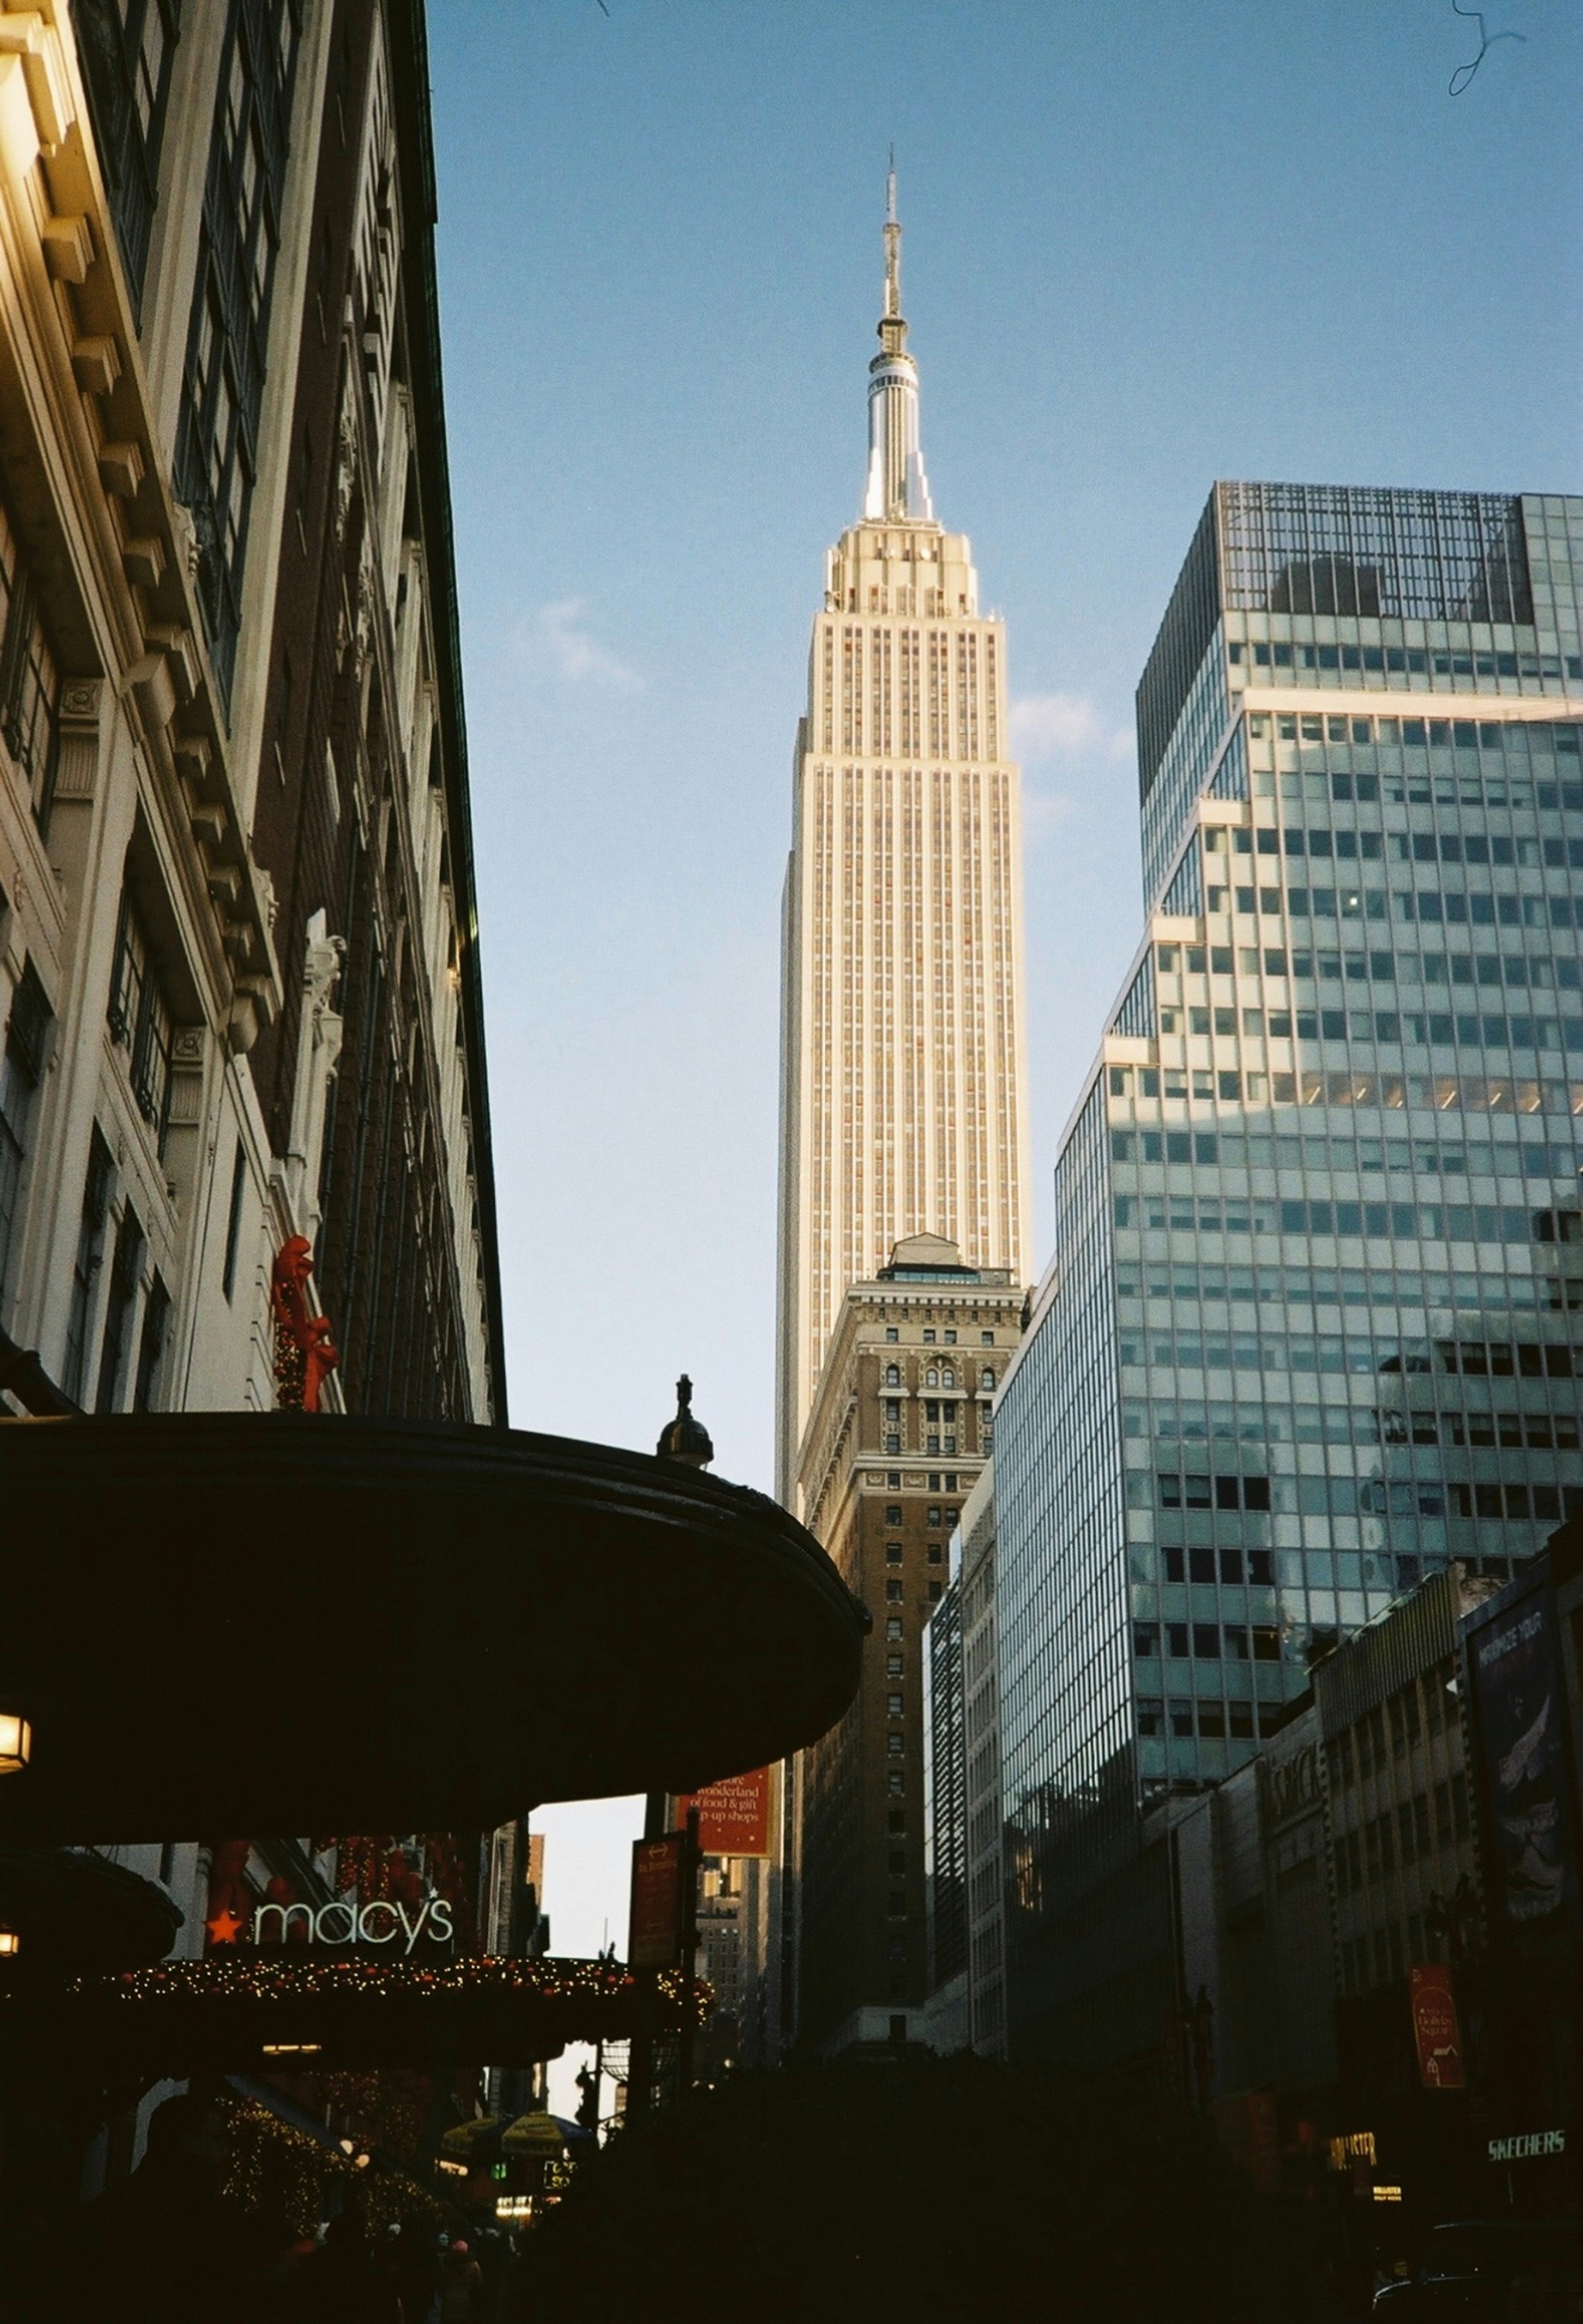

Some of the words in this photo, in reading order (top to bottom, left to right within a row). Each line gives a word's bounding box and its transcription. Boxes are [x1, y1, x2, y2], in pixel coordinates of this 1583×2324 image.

[697, 1785, 760, 1797] wonderland
[689, 1797, 701, 1806] of
[701, 1797, 727, 1808] food
[729, 1798, 737, 1809] &
[739, 1798, 757, 1811] gift
[728, 1810, 760, 1824] shops
[1488, 2128, 1566, 2163] SKECHERS
